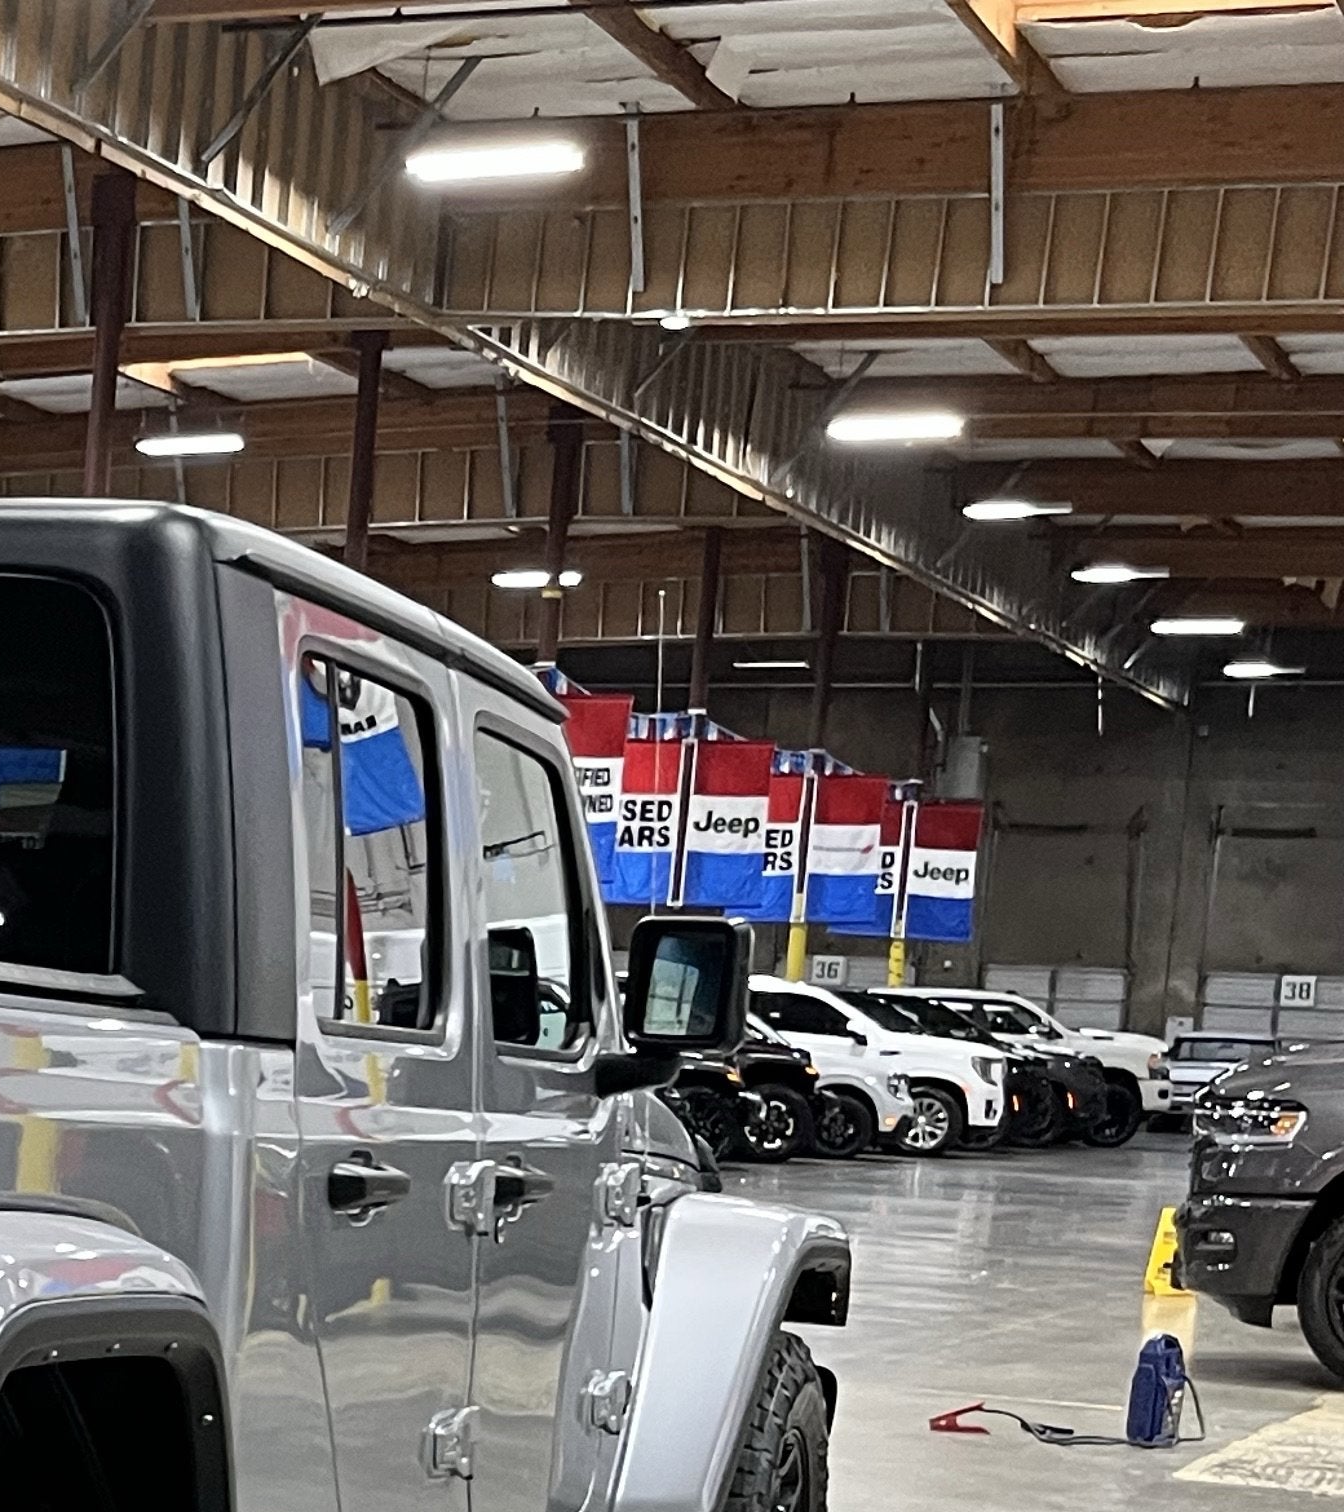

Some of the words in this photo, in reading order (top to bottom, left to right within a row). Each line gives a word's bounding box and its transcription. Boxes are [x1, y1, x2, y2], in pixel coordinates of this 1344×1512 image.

[621, 799, 673, 822] SED
[693, 810, 760, 838] Jeep
[619, 826, 670, 848] ARS
[765, 829, 793, 848] ED
[763, 852, 793, 871] RS
[914, 861, 969, 885] Jeep
[815, 961, 840, 979] 36
[1284, 981, 1311, 1000] 38
